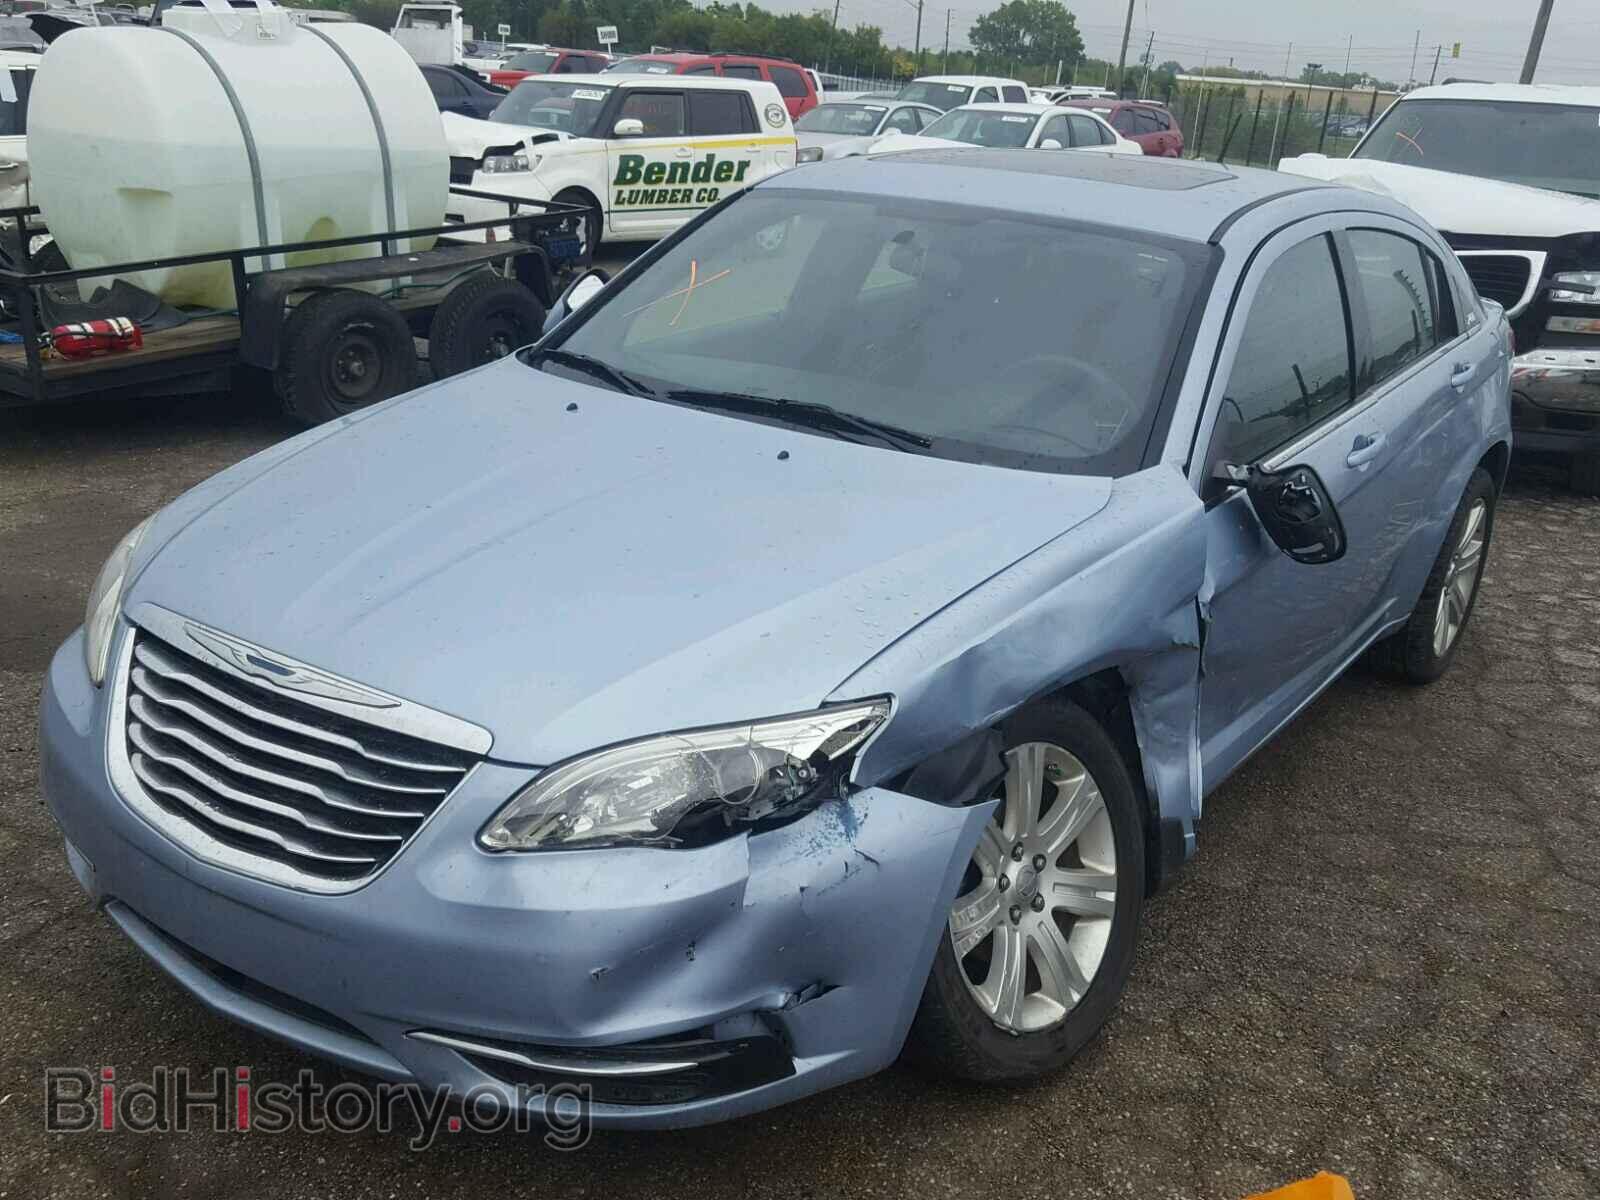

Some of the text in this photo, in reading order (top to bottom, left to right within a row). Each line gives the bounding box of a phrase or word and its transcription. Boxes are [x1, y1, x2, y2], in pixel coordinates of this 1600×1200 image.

[613, 153, 751, 186] Bender
[614, 187, 720, 205] LUMBER CO.
